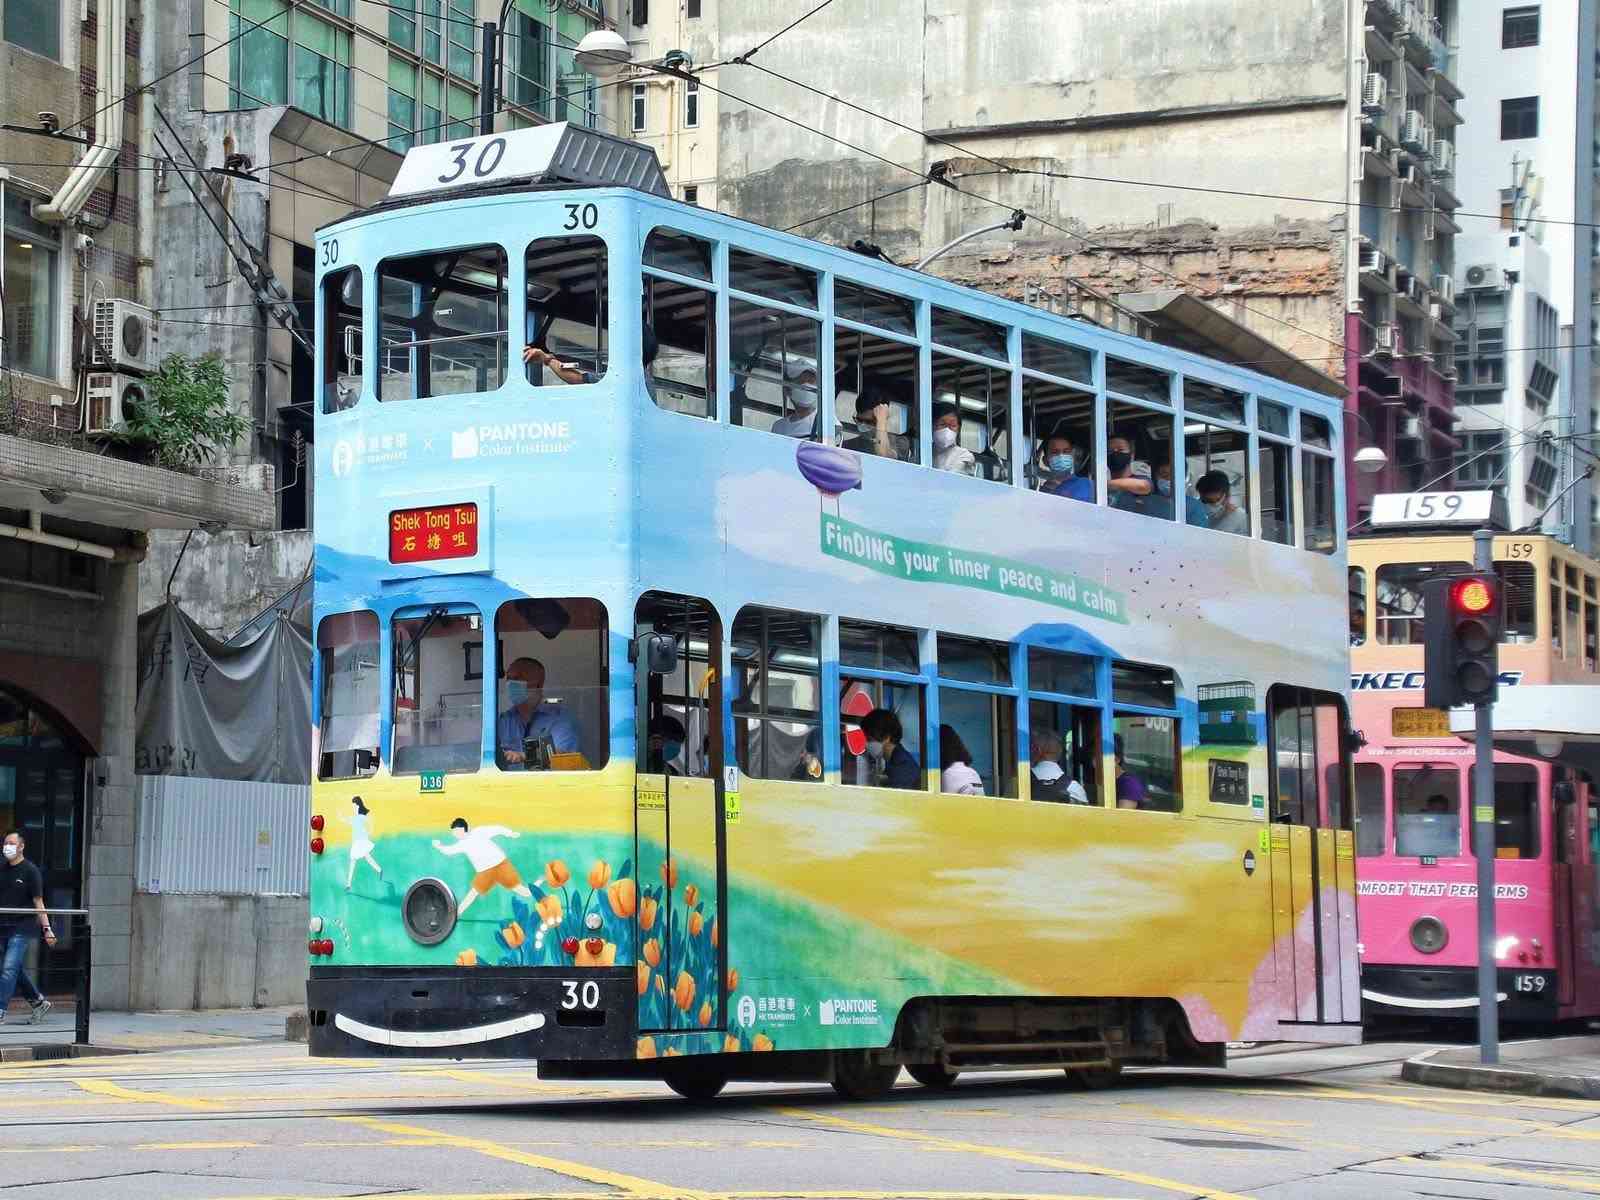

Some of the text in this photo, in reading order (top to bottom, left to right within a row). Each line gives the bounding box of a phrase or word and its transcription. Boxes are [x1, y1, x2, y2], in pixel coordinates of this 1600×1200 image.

[438, 137, 507, 184] 30
[563, 202, 599, 230] 30
[321, 238, 340, 266] 30
[479, 421, 569, 442] PANTONE
[1402, 494, 1463, 519] 159
[393, 508, 476, 531] Shek Tong Tsui
[401, 531, 468, 551] 石塘咀
[1504, 543, 1534, 559] 159
[825, 521, 1118, 614] FinDING your inner peace and calm
[1350, 671, 1522, 690] SKECS
[726, 810, 739, 820] EXIT
[1356, 881, 1528, 899] MFORT THAT PERRMS
[560, 979, 600, 1010] 30
[1515, 976, 1546, 992] 159
[834, 999, 878, 1013] PANTONE
